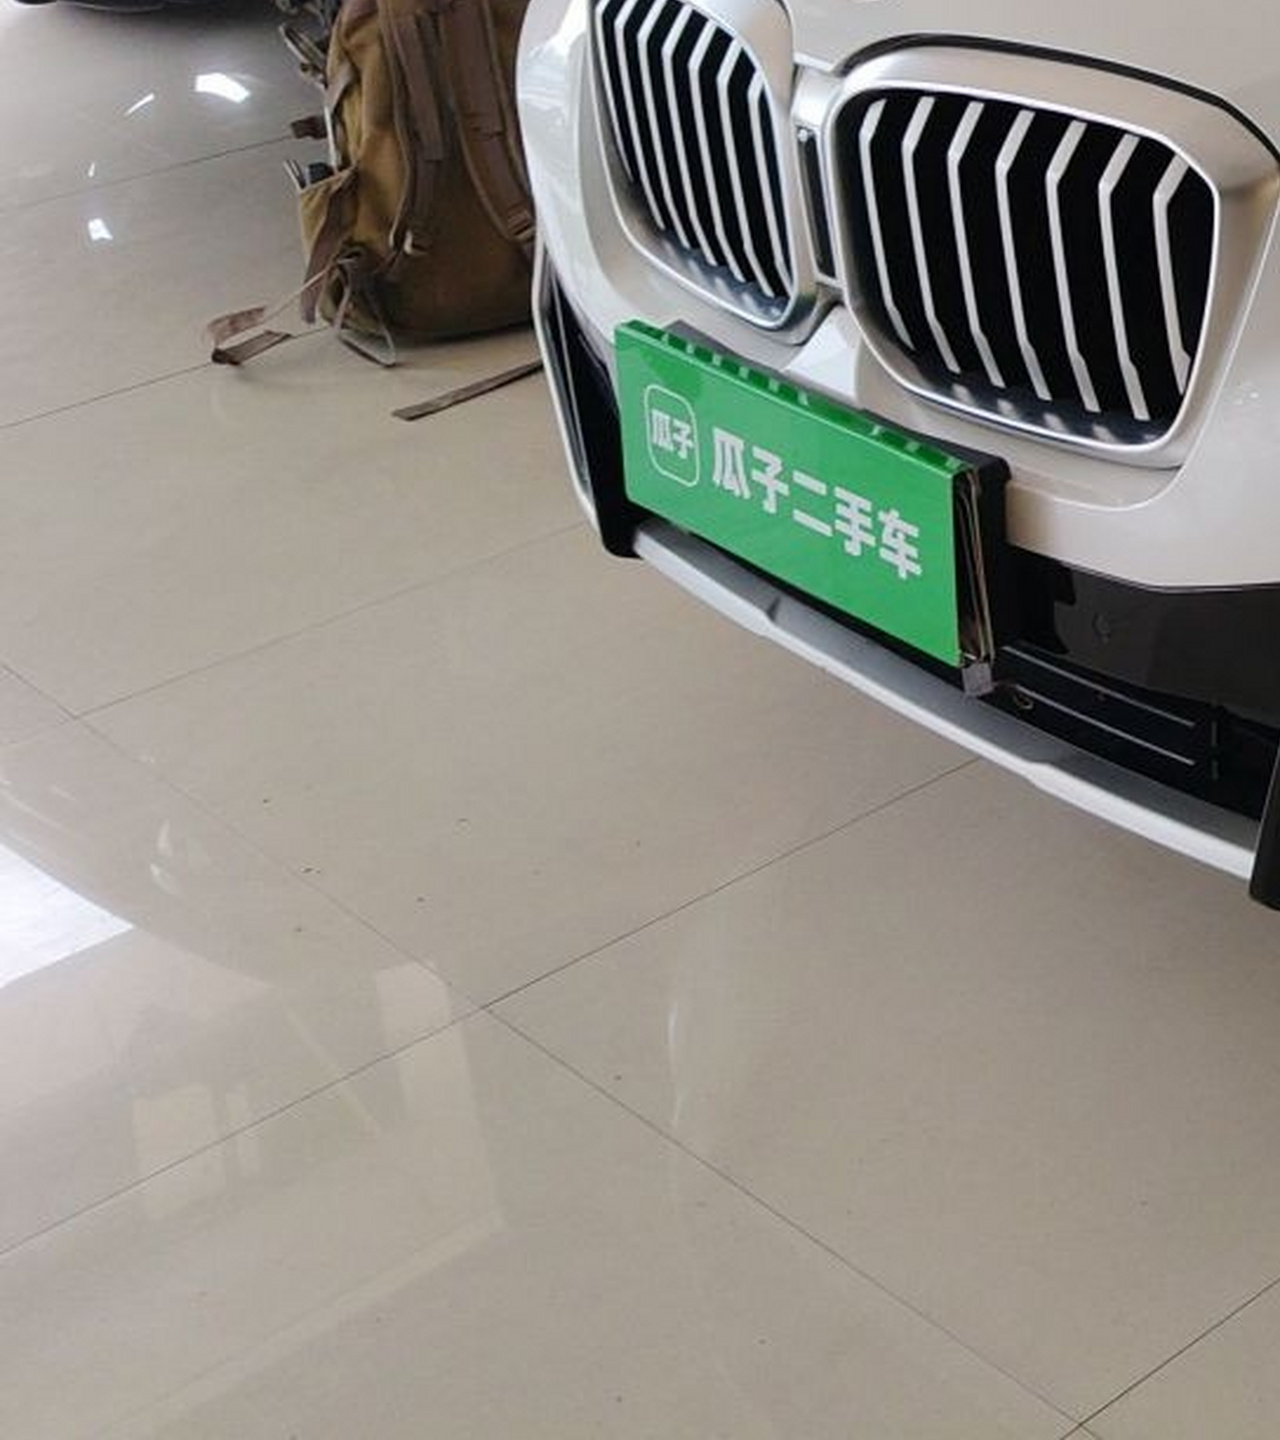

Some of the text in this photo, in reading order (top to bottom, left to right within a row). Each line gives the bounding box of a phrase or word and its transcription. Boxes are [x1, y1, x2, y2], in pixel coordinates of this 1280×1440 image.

[650, 409, 695, 460] 瓜子
[711, 426, 922, 580] 瓜子二手车
